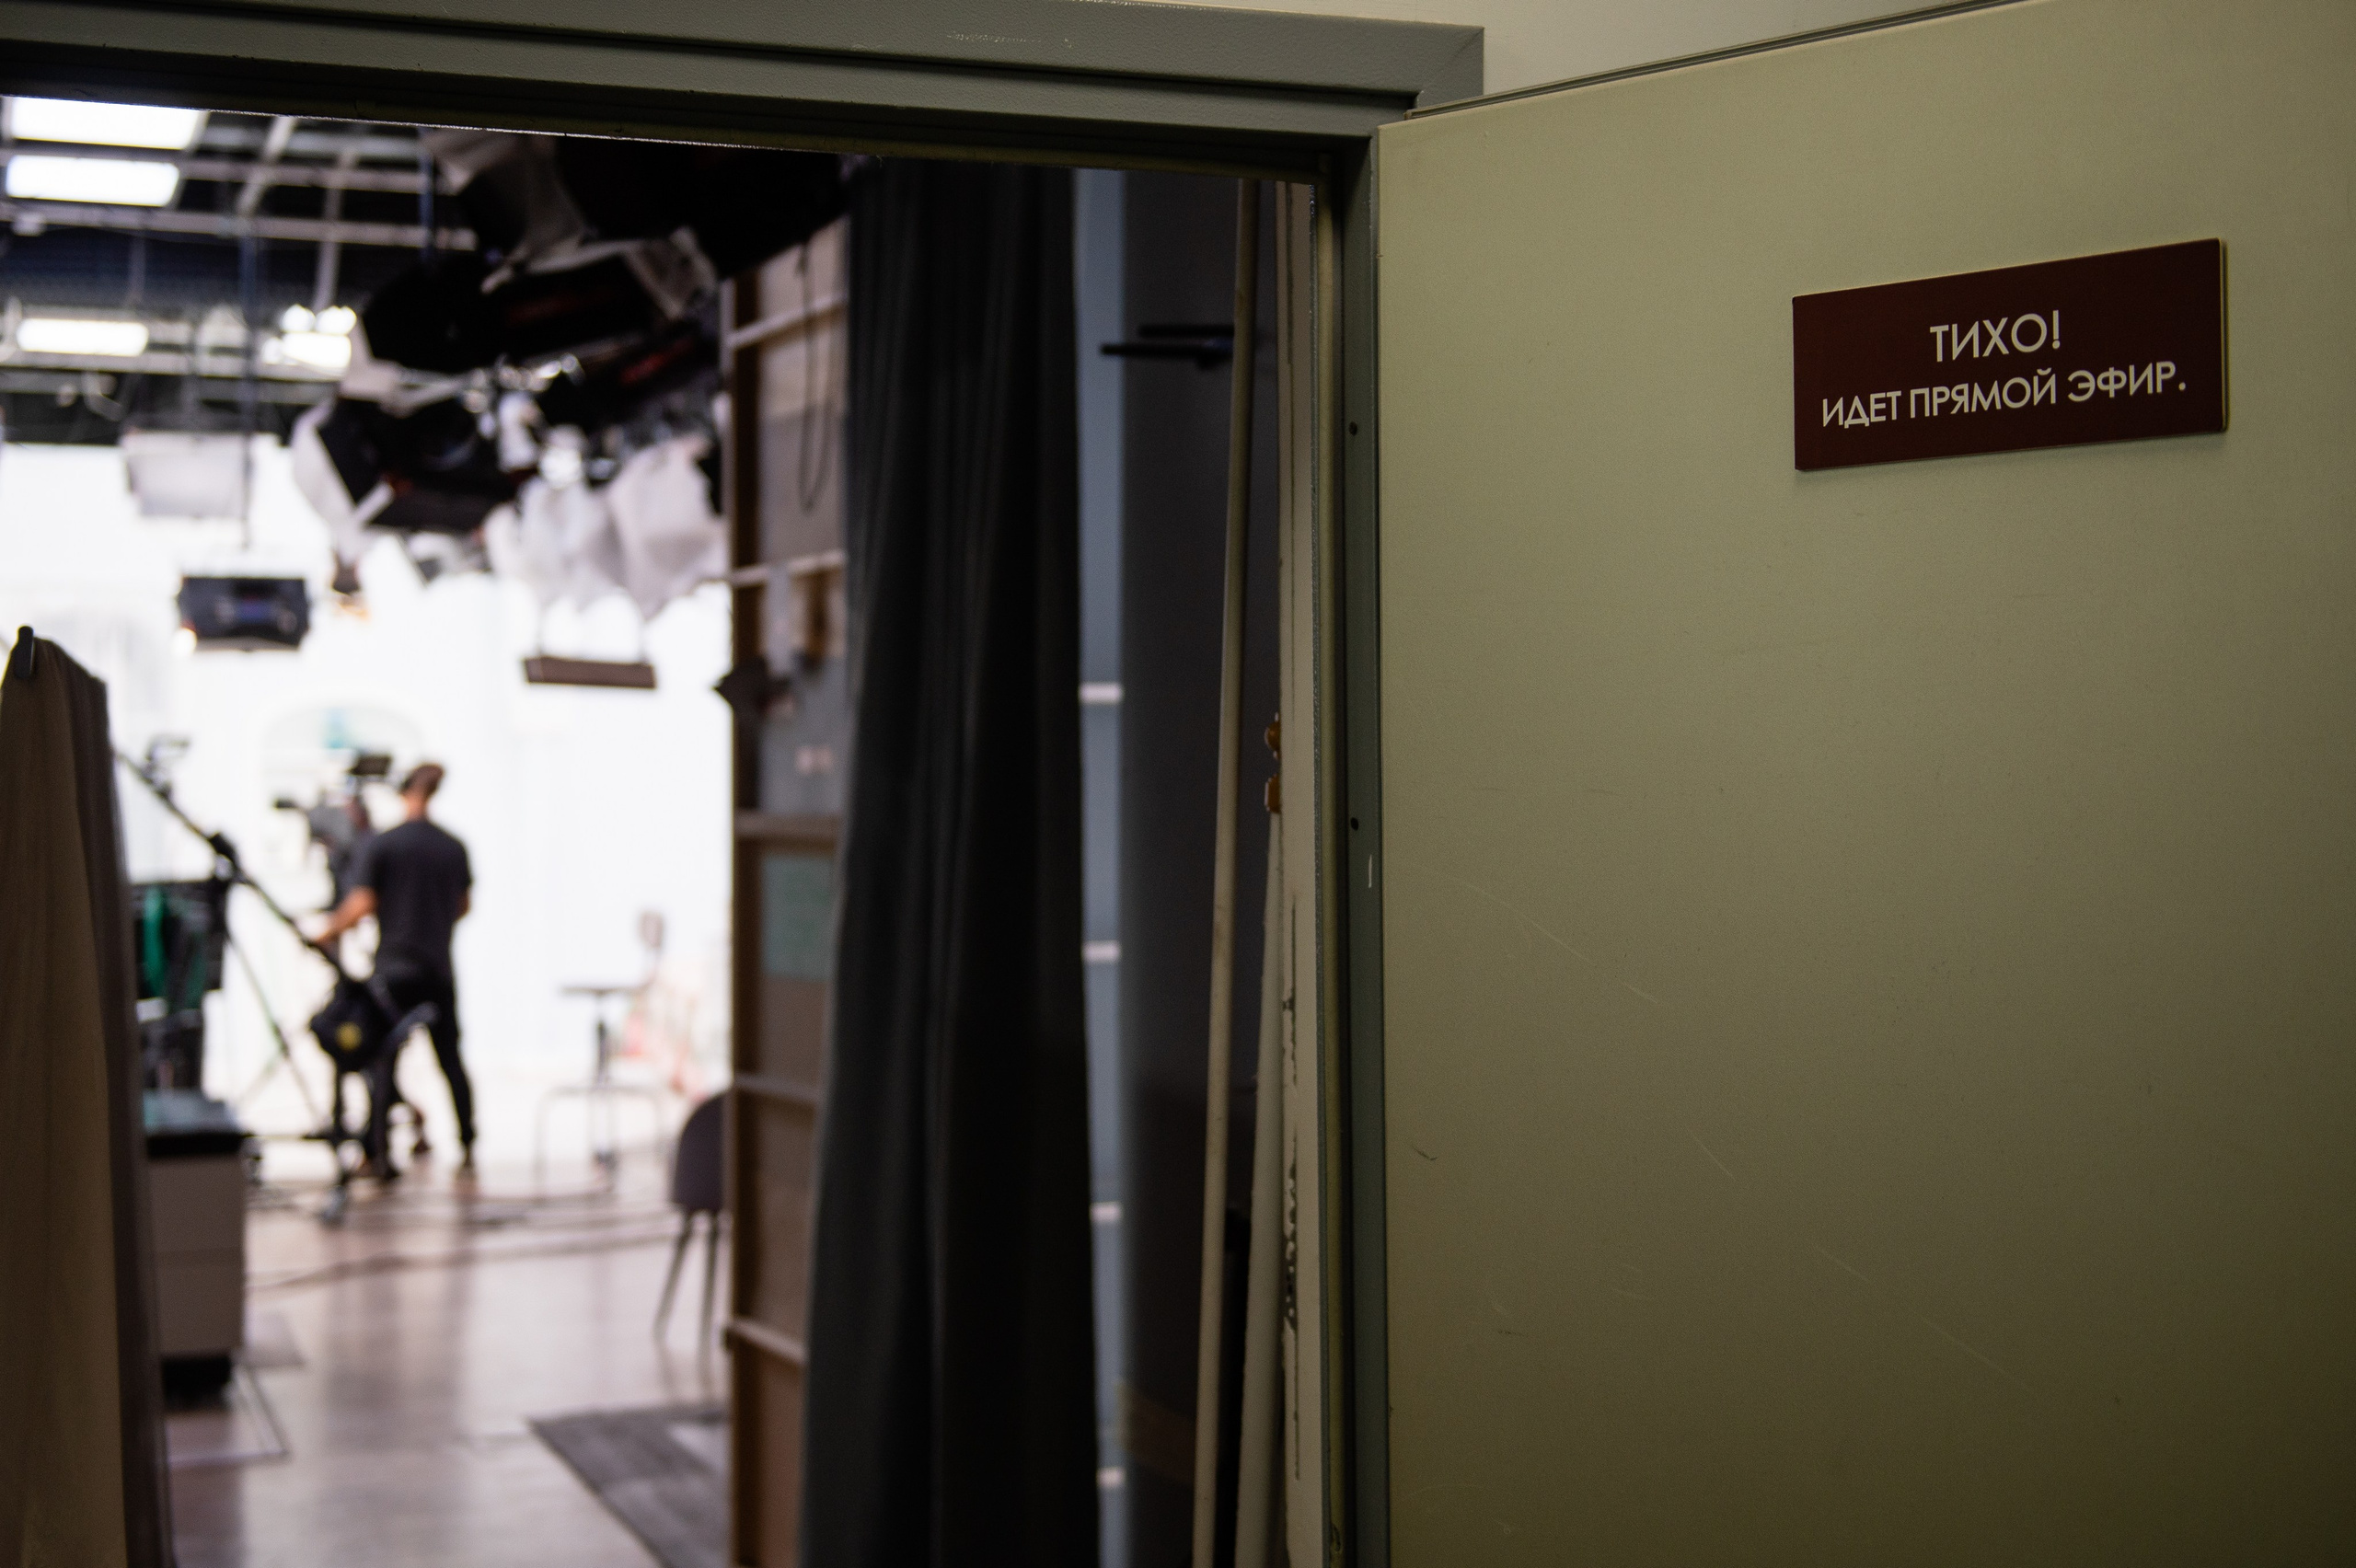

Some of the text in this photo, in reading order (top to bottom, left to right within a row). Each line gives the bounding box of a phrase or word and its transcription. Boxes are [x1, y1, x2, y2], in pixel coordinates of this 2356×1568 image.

[1929, 309, 2062, 363] ТИХО!
[1822, 361, 2187, 429] ИДЕТ ПРЯМОЙ ЭФИР.
